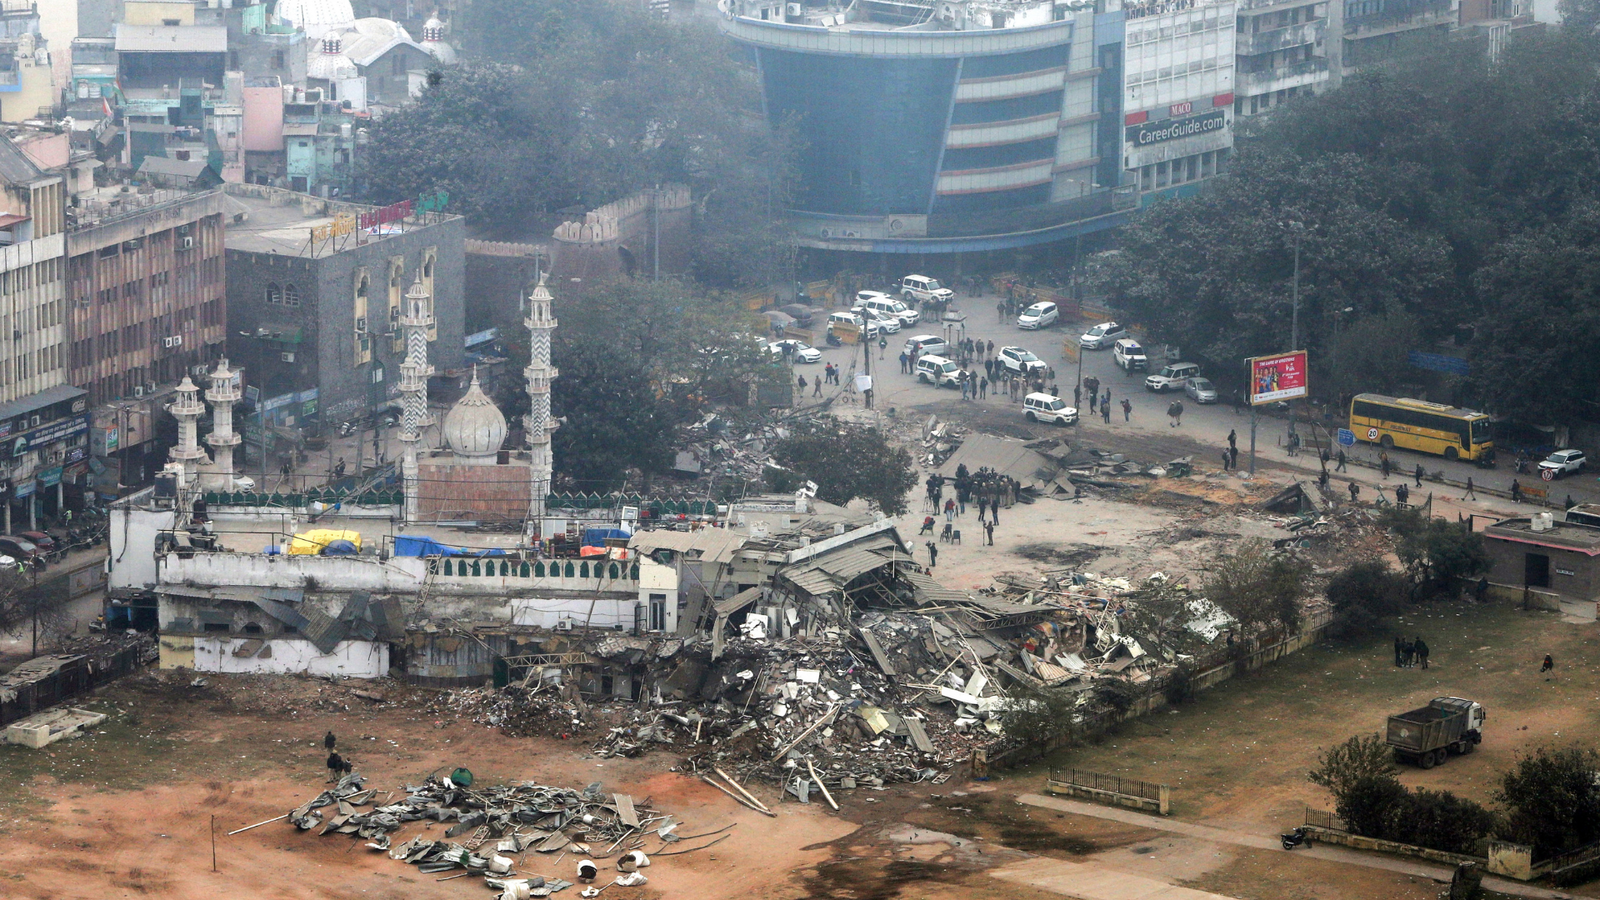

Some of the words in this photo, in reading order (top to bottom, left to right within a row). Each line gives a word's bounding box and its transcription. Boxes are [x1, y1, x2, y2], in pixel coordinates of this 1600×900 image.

[1171, 103, 1191, 115] MACO
[1139, 117, 1223, 144] CareerGuide.com
[1368, 430, 1377, 438] 20
